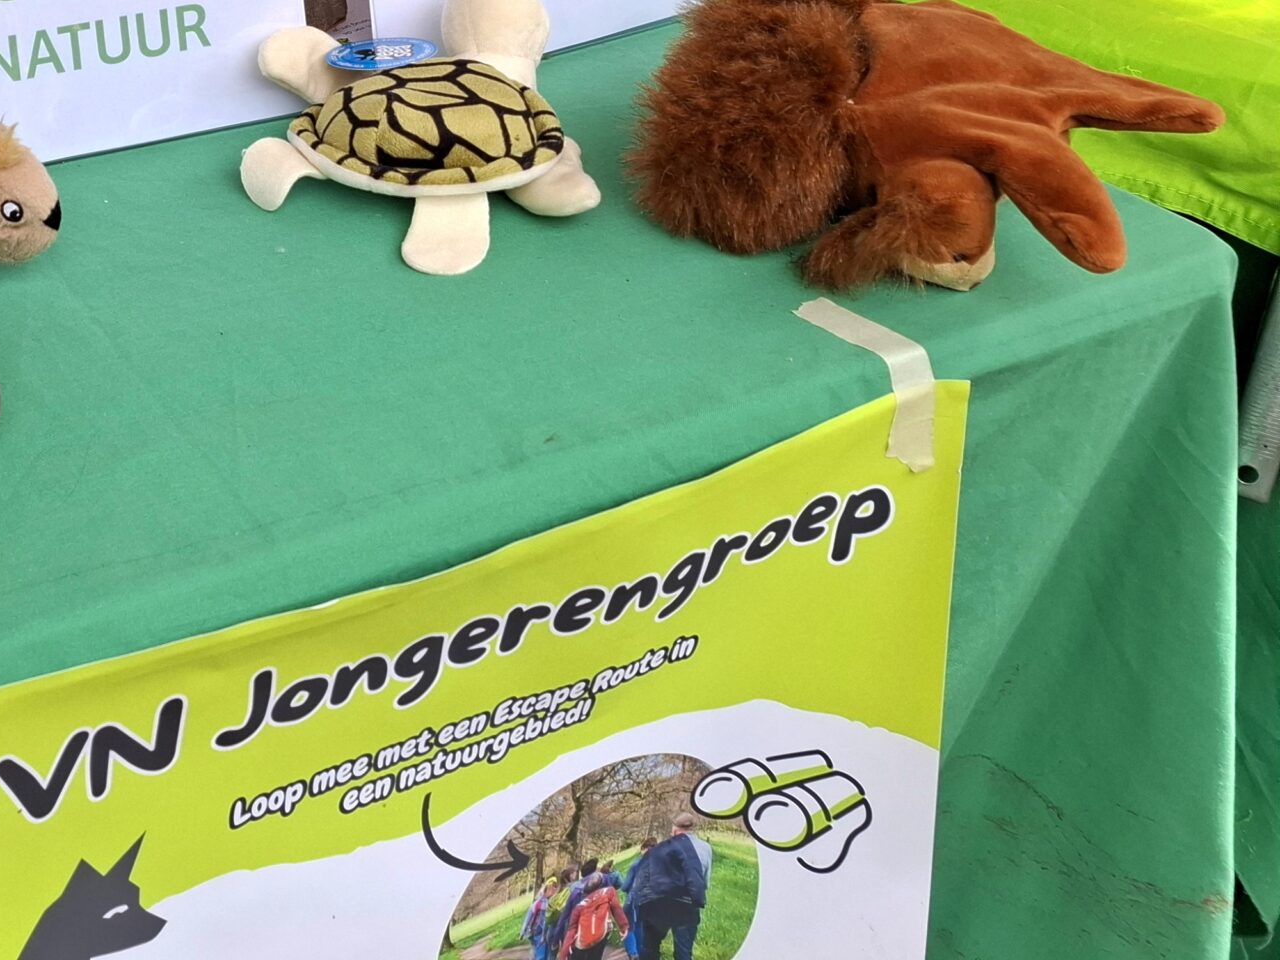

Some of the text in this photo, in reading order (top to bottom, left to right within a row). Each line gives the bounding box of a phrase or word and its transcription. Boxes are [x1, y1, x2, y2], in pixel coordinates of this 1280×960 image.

[212, 484, 893, 748] Jongerengroep
[230, 634, 697, 829] Loop mee met een Escape Route in
[341, 696, 594, 814] een natuurgebied!
